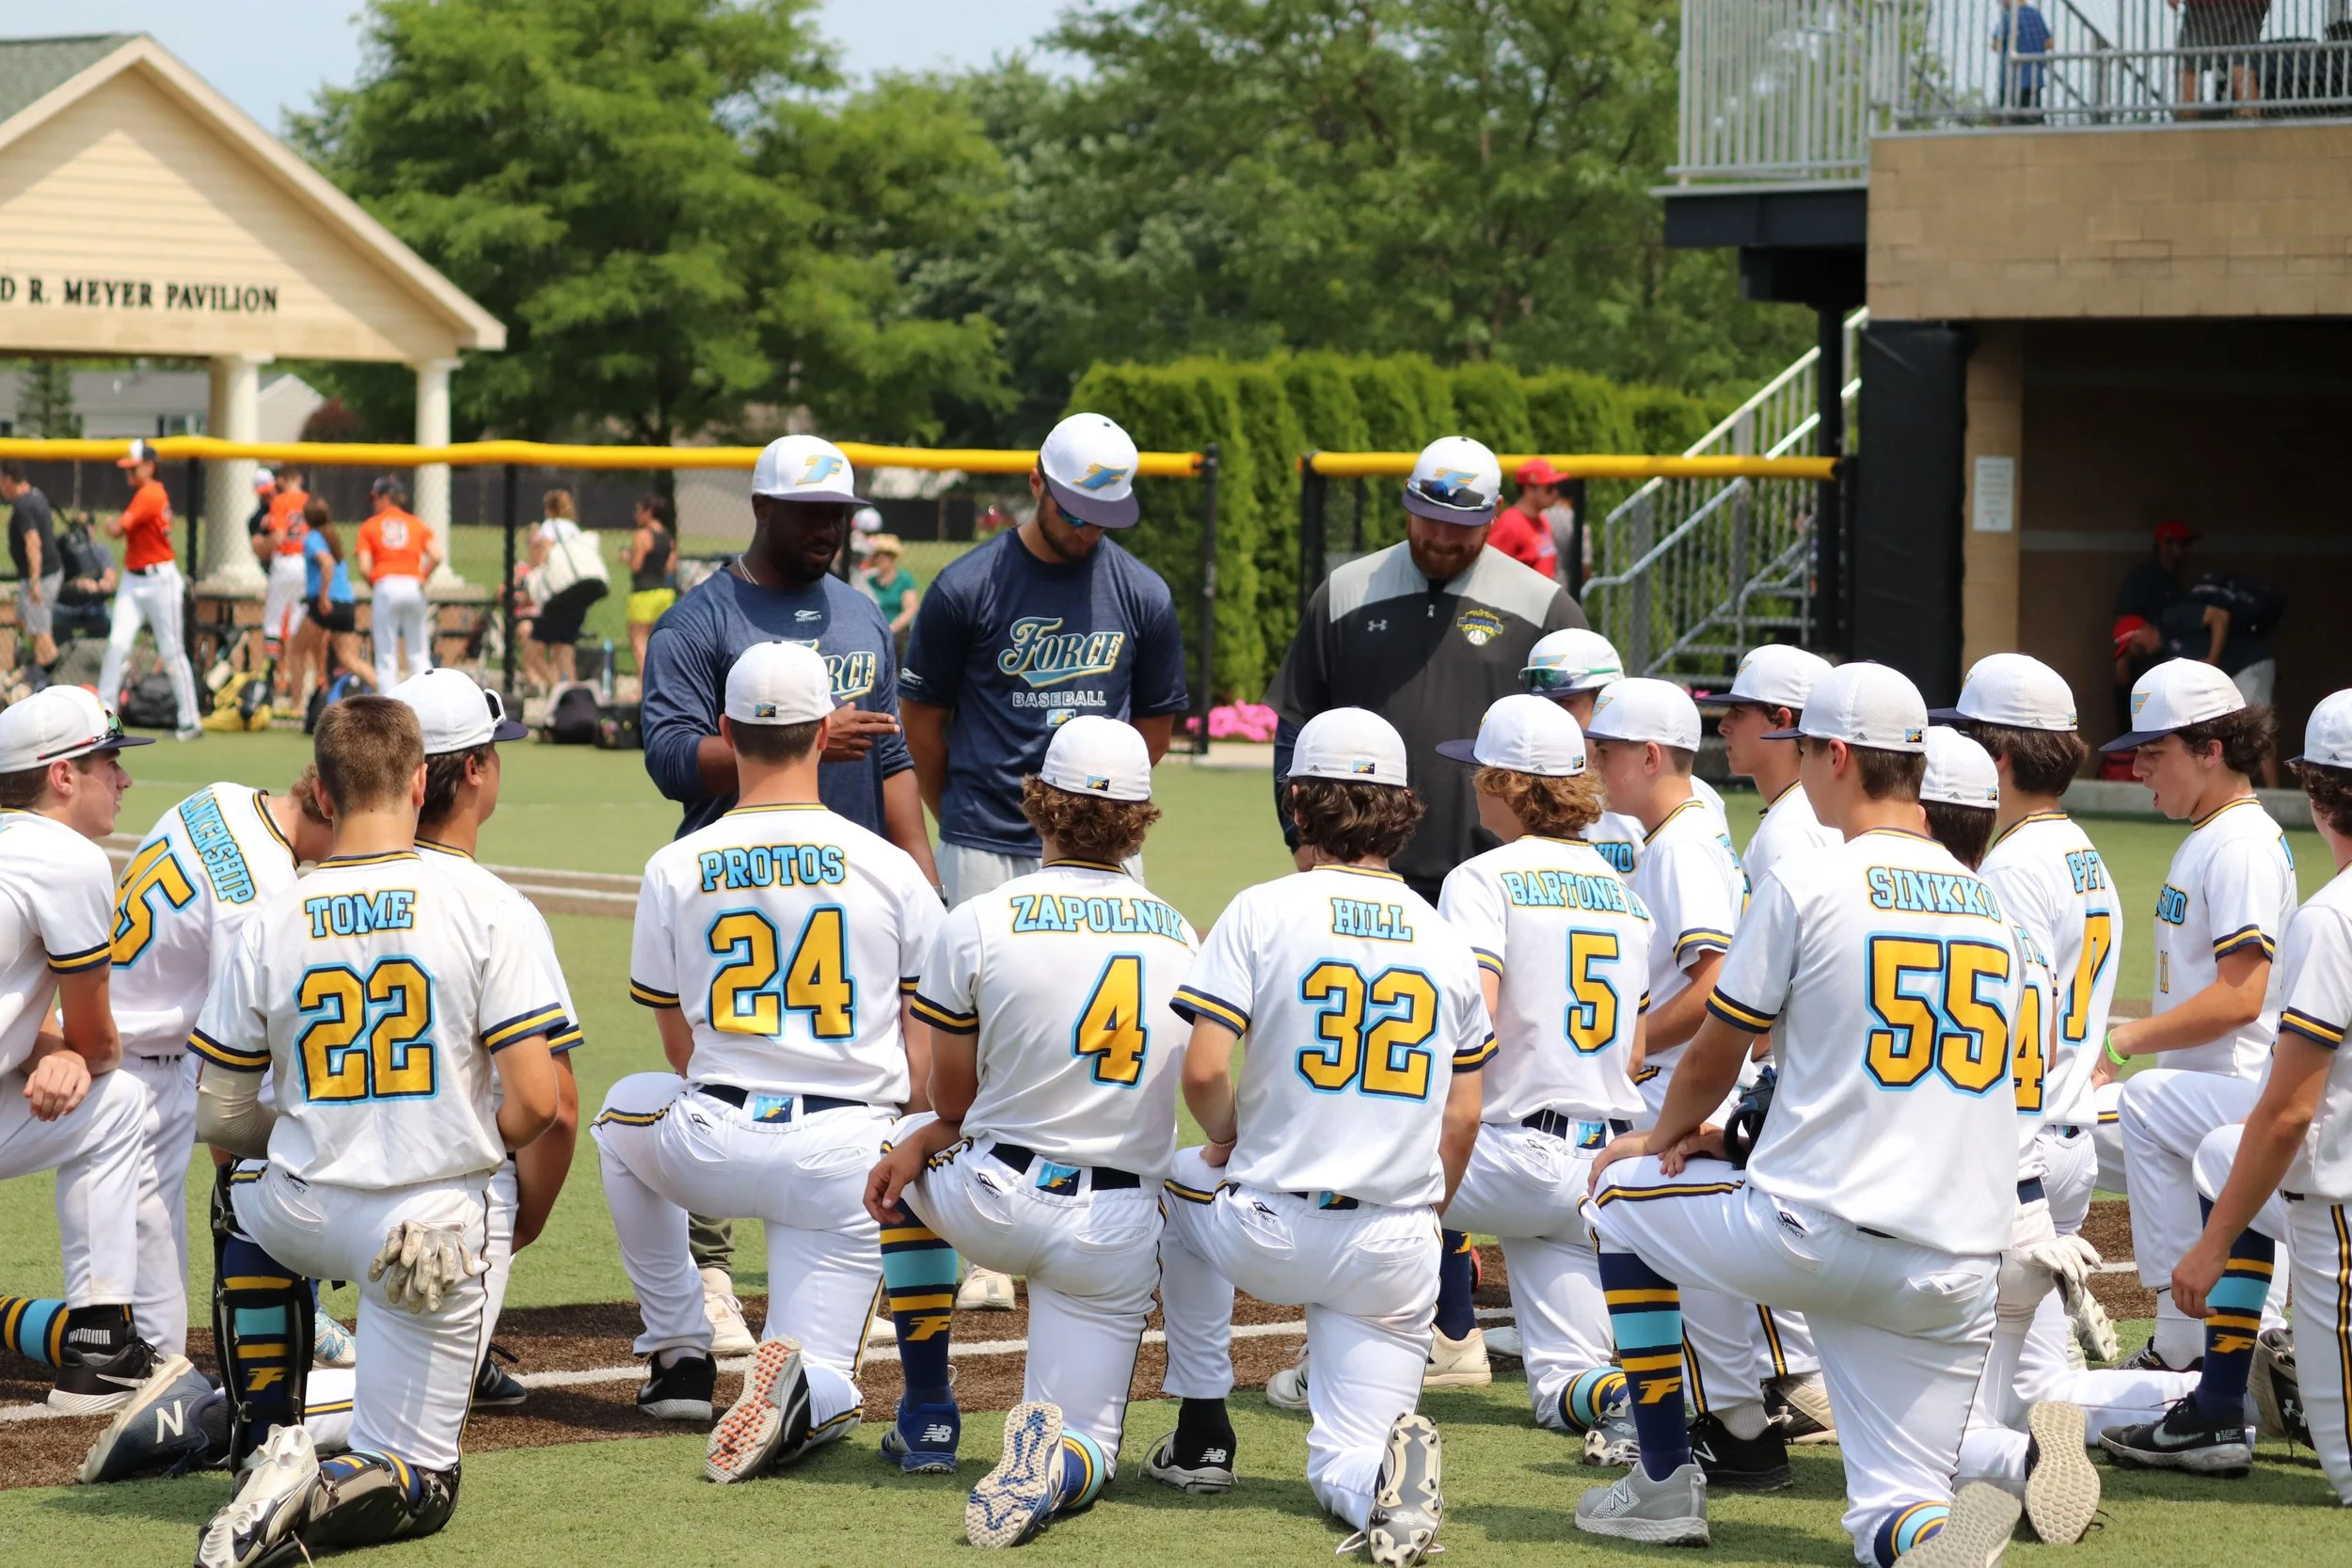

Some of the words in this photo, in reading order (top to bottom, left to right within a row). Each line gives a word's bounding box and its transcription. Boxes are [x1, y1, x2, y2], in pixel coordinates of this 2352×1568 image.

[29, 277, 50, 304] R.
[64, 278, 152, 307] MEYER
[165, 282, 277, 311] PAVILION
[1012, 690, 1106, 707] BASEBALL
[698, 844, 846, 893] PROTOS
[1500, 870, 1628, 914] BARTONE
[304, 889, 417, 940] TOME
[1329, 896, 1414, 943] HILL
[1867, 865, 2002, 925] SINKKO
[1009, 894, 1189, 948] ZAPOLNIK
[706, 904, 858, 1043] 24
[1564, 926, 1620, 1057] 5
[293, 955, 439, 1106] 22
[1070, 951, 1152, 1090] 4
[1295, 957, 1442, 1105] 32
[1861, 930, 2010, 1099] 55
[1247, 1206, 1277, 1226] INSTINCT
[156, 1399, 184, 1445] N
[920, 1423, 953, 1443] NB
[1199, 1448, 1227, 1464] NB
